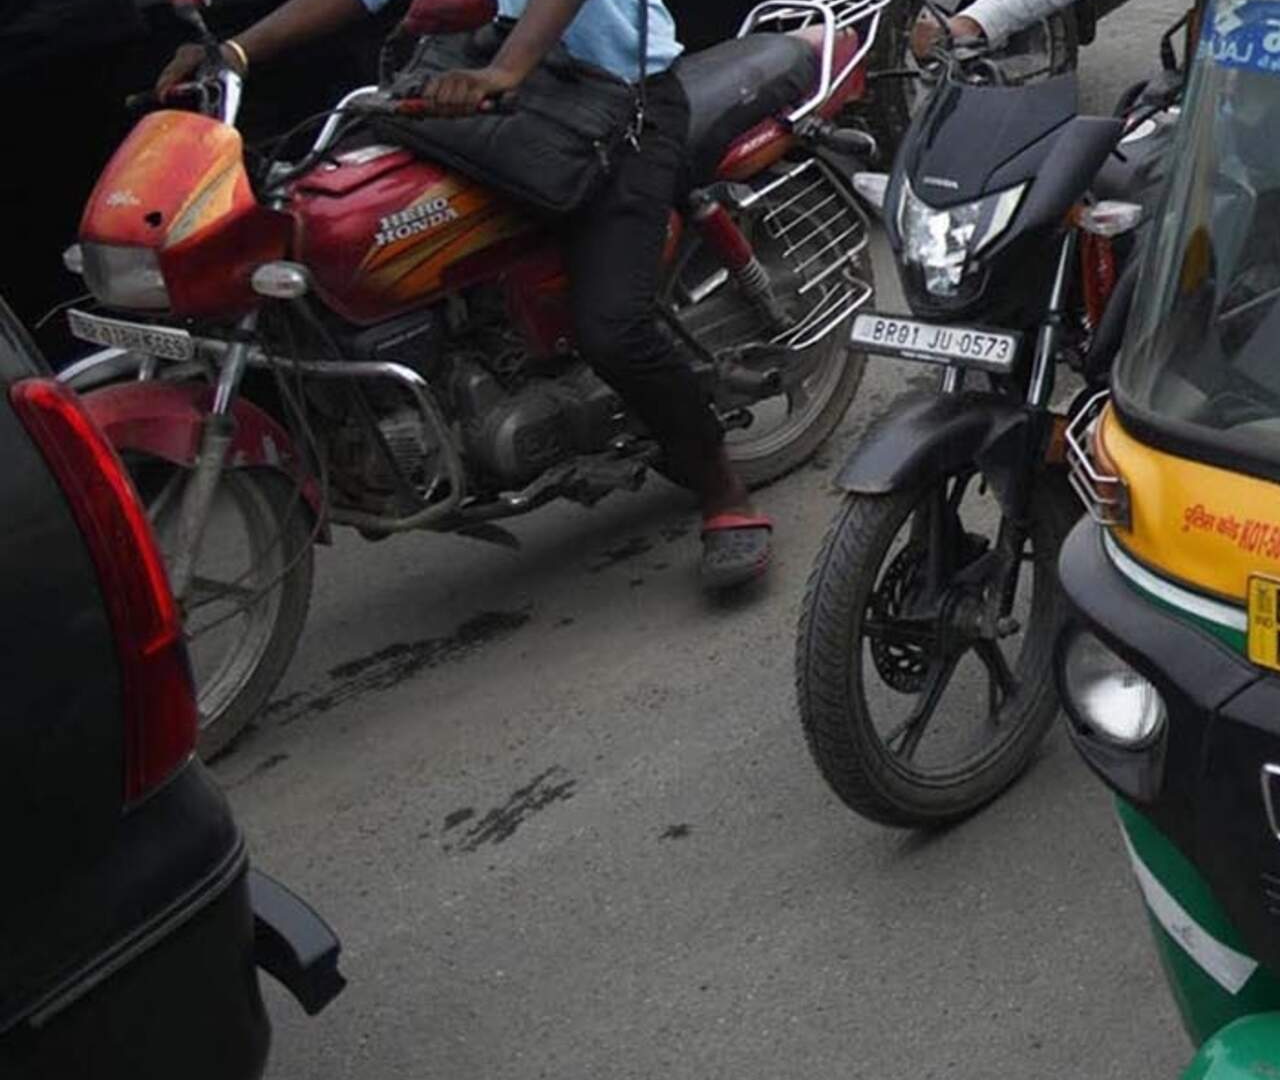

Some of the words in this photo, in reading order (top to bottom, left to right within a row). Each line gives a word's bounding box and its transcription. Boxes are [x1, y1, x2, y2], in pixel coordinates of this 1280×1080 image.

[374, 207, 460, 246] HONDA
[379, 197, 448, 230] HERO
[928, 328, 953, 351] JU
[960, 333, 1010, 360] 0573
